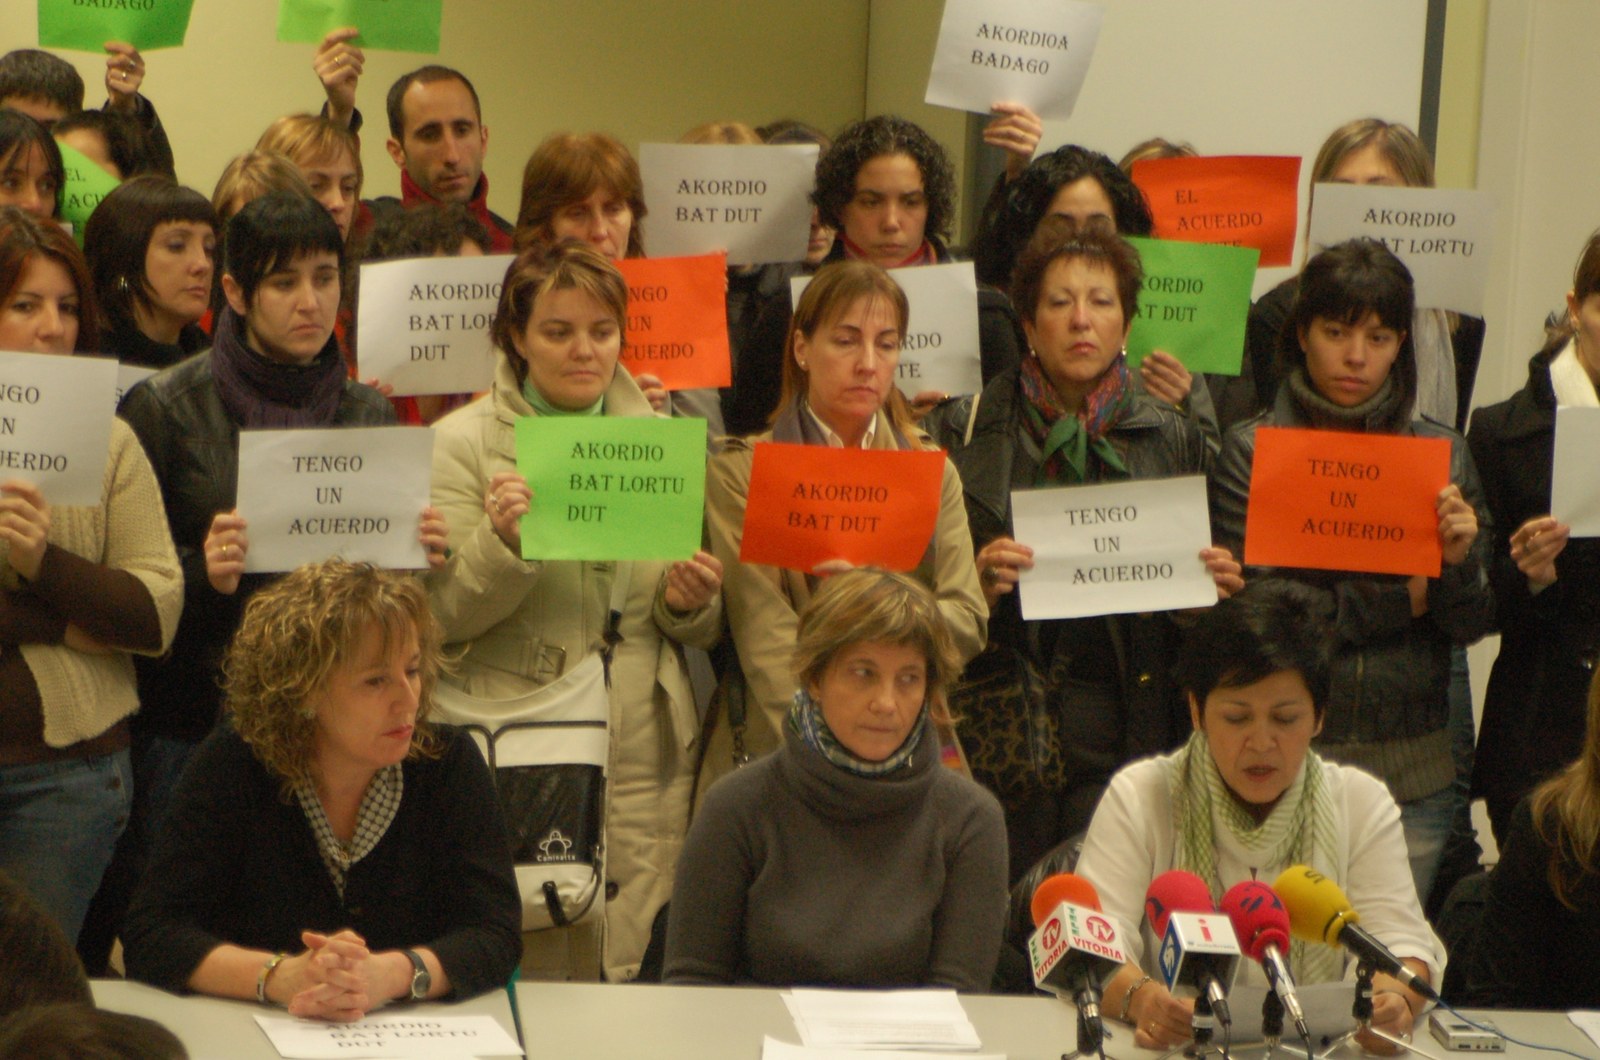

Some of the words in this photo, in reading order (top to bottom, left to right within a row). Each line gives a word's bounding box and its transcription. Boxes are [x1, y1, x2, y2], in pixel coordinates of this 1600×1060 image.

[976, 23, 1067, 50] AKORDIOA
[971, 49, 1049, 75] BADAGO
[677, 179, 767, 195] AKORDIO
[1175, 190, 1198, 205] EL
[676, 206, 718, 222] BAT
[725, 208, 762, 223] DUT
[1177, 212, 1263, 231] ACUERDO
[1363, 208, 1456, 228] AKORDIO
[1410, 238, 1474, 257] LORTU
[409, 283, 503, 301] AKORDIO
[629, 285, 668, 302] NGO
[1142, 276, 1203, 294] ORDIO
[409, 314, 454, 331] BAT
[1163, 305, 1197, 322] DUT
[627, 315, 651, 332] UN
[410, 344, 450, 361] DUT
[622, 343, 694, 361] CUERDO
[1, 417, 15, 435] N
[571, 442, 664, 461] AKORDIO
[292, 455, 363, 473] TENGO
[1308, 458, 1380, 481] TENGO
[570, 473, 613, 491] BAT
[620, 475, 685, 494] LORTU
[316, 487, 342, 504] UN
[792, 483, 889, 503] AKORDIO
[1330, 491, 1357, 508] UN
[568, 504, 607, 522] DUT
[787, 511, 834, 531] BAT
[840, 515, 881, 533] DUT
[1064, 505, 1137, 526] TENGO
[288, 517, 390, 535] ACUERDO
[1301, 518, 1405, 542] ACUERDO
[1093, 536, 1120, 553] UN
[1072, 562, 1173, 585] ACUERDO
[1043, 920, 1060, 949] TV
[1087, 919, 1113, 941] TV
[1073, 936, 1123, 961] VITORIA
[1035, 939, 1068, 980] VITORIA
